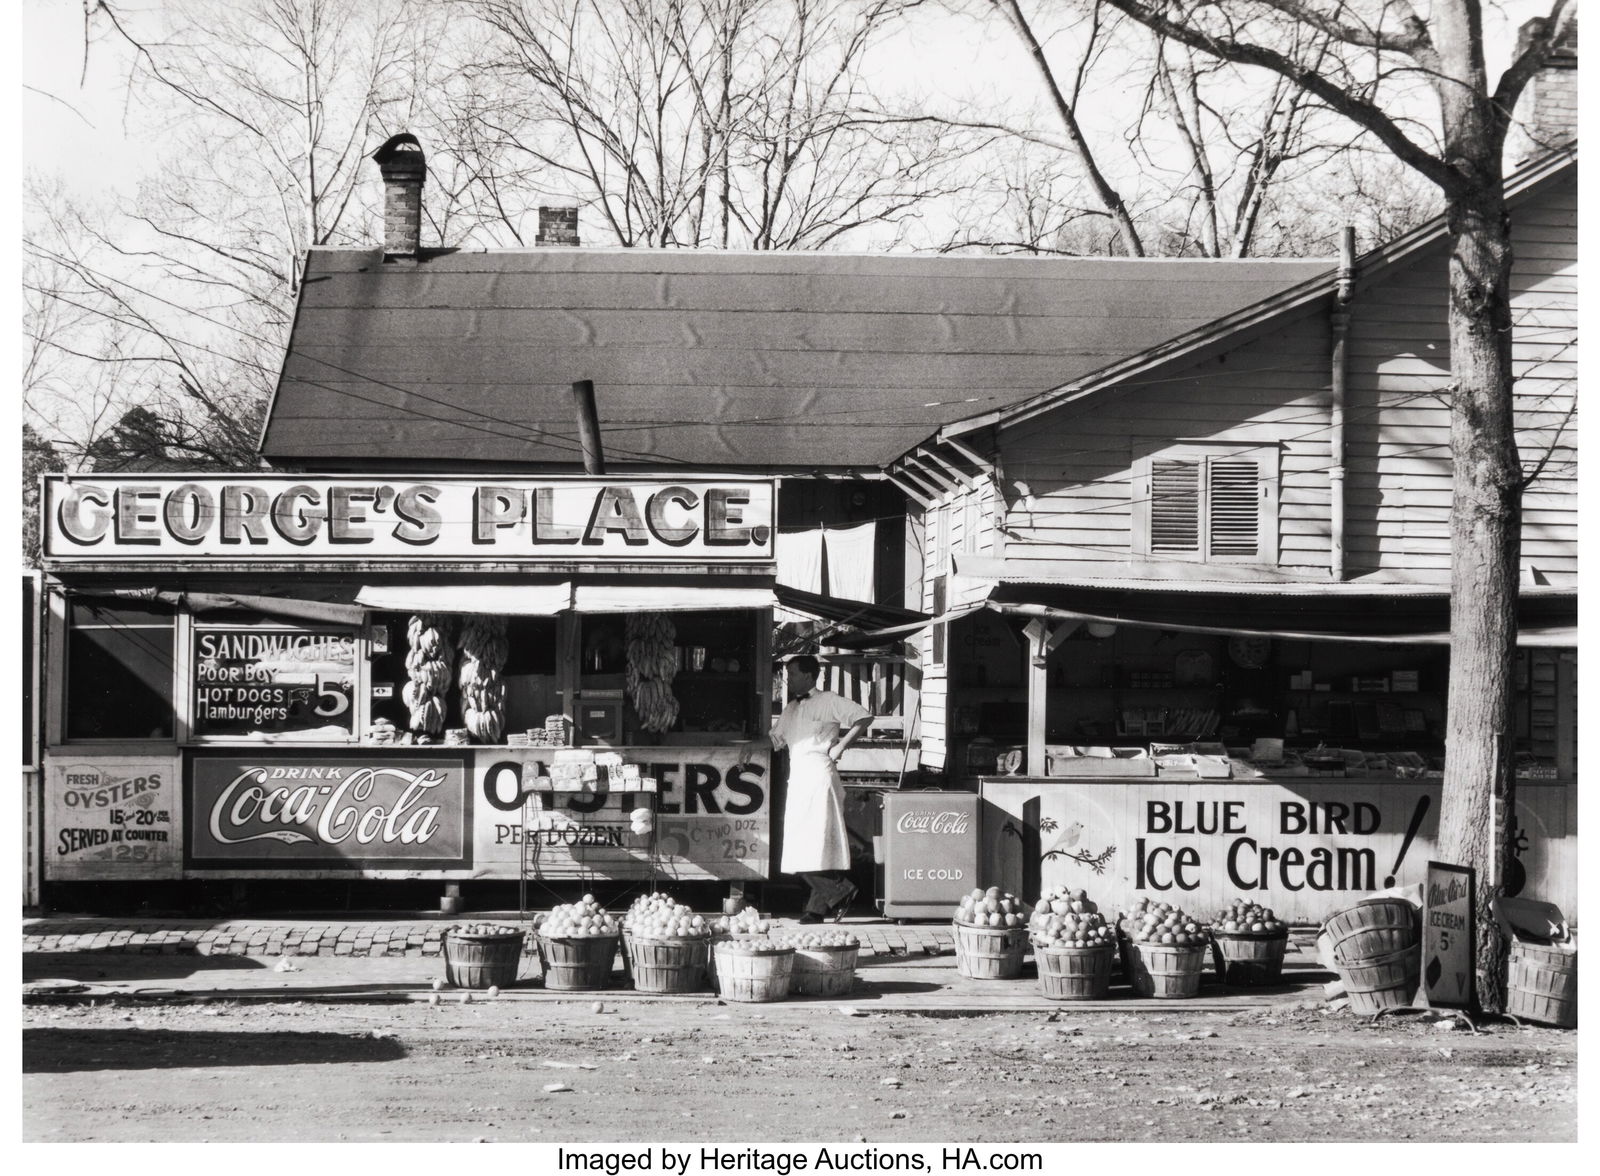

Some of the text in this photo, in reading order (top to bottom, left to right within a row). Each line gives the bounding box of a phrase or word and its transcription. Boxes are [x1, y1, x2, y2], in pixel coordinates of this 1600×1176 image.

[57, 484, 770, 546] GEORGE'S PLACE.
[199, 635, 354, 662] SANDWICHES
[197, 688, 284, 703] HOT DOGS
[197, 700, 287, 724] Hamburgers
[66, 774, 99, 785] FRESH
[270, 768, 342, 779] DRINK
[64, 774, 161, 809] OYSTERS
[209, 767, 447, 845] Coca-Cola
[897, 811, 969, 834] Coca-Cola
[1146, 801, 1381, 835] BLUE BIRD
[58, 828, 168, 855] SERVED AT COUNTER
[495, 824, 624, 846] PER DOZEN
[707, 823, 731, 840] TWO
[904, 869, 963, 880] ICE COLD
[1135, 837, 1201, 891] Ice
[1430, 909, 1465, 931] ICE CREAM
